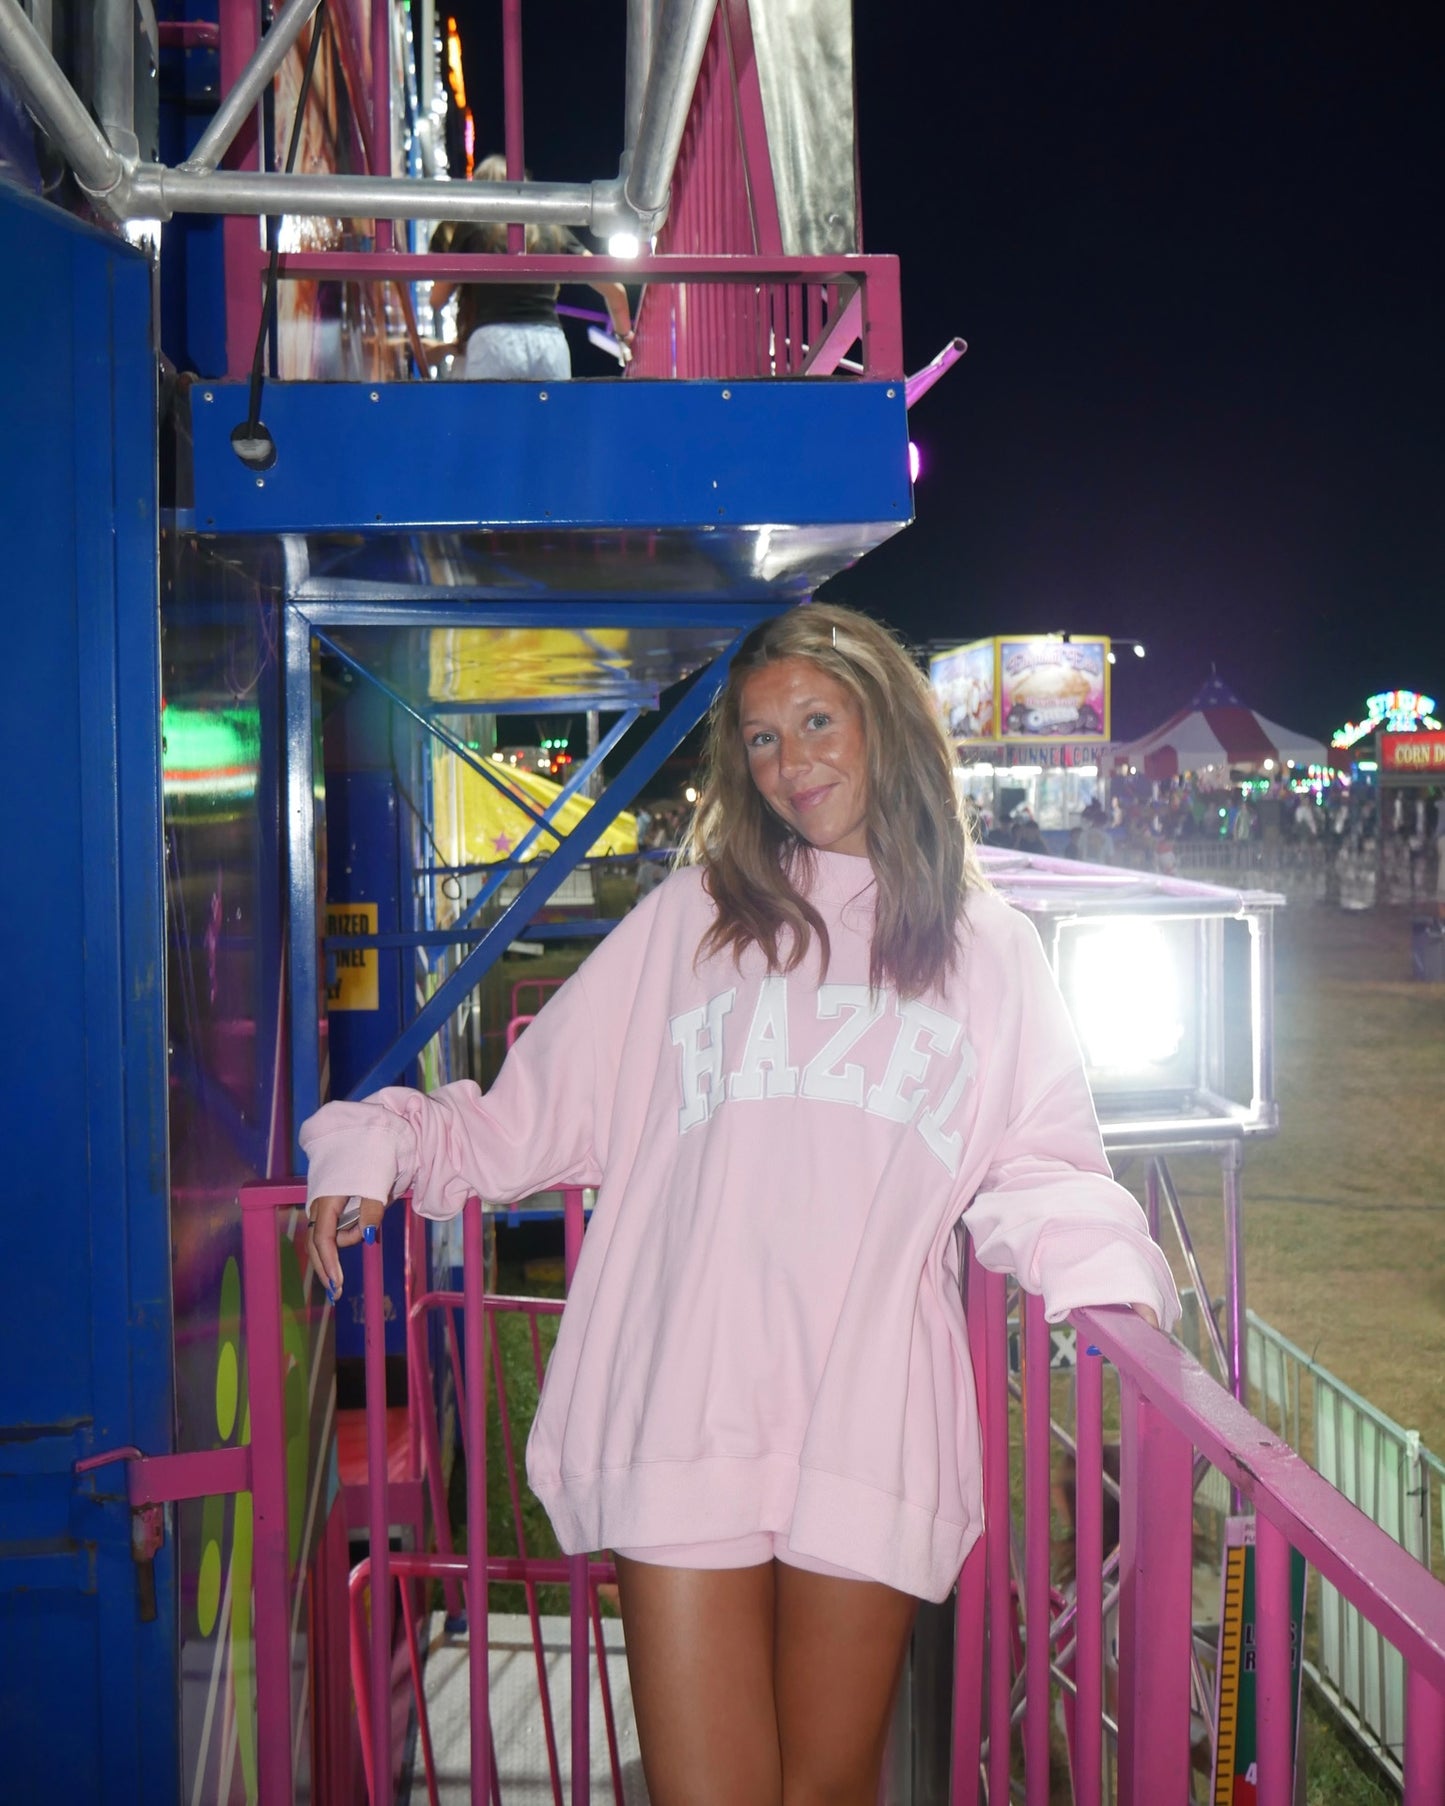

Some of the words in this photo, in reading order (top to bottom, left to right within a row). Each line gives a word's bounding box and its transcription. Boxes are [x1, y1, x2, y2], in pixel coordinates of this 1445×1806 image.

[1007, 745, 1066, 769] FUNNEL
[1395, 743, 1429, 764] CORN
[668, 975, 978, 1180] HAZEL
